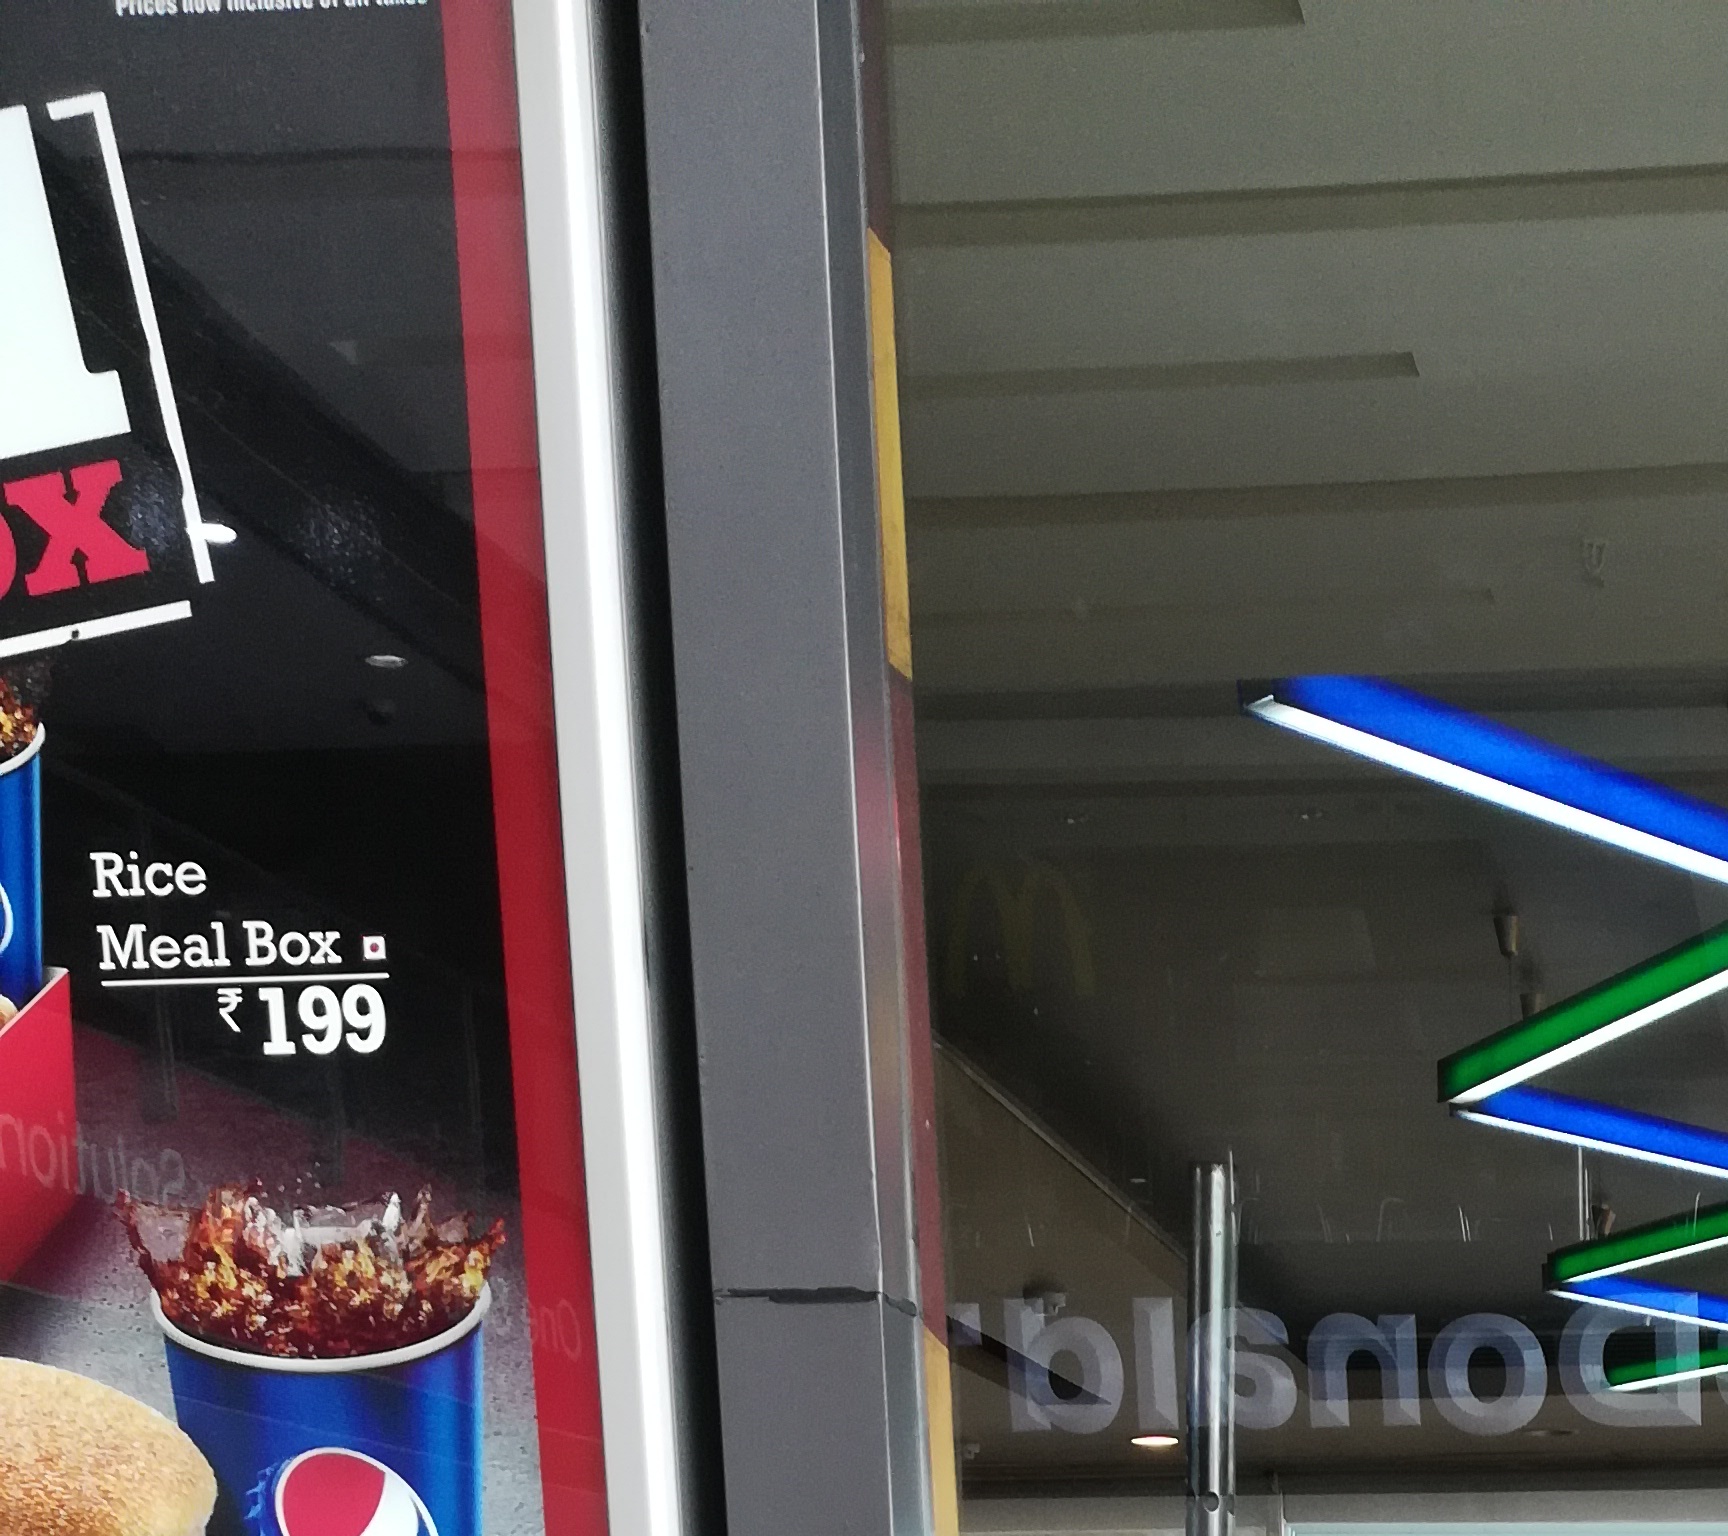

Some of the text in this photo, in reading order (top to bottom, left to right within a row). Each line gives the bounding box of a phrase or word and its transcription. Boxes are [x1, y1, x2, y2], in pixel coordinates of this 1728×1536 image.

[90, 851, 207, 898] Rice
[97, 919, 342, 970] Meal Box
